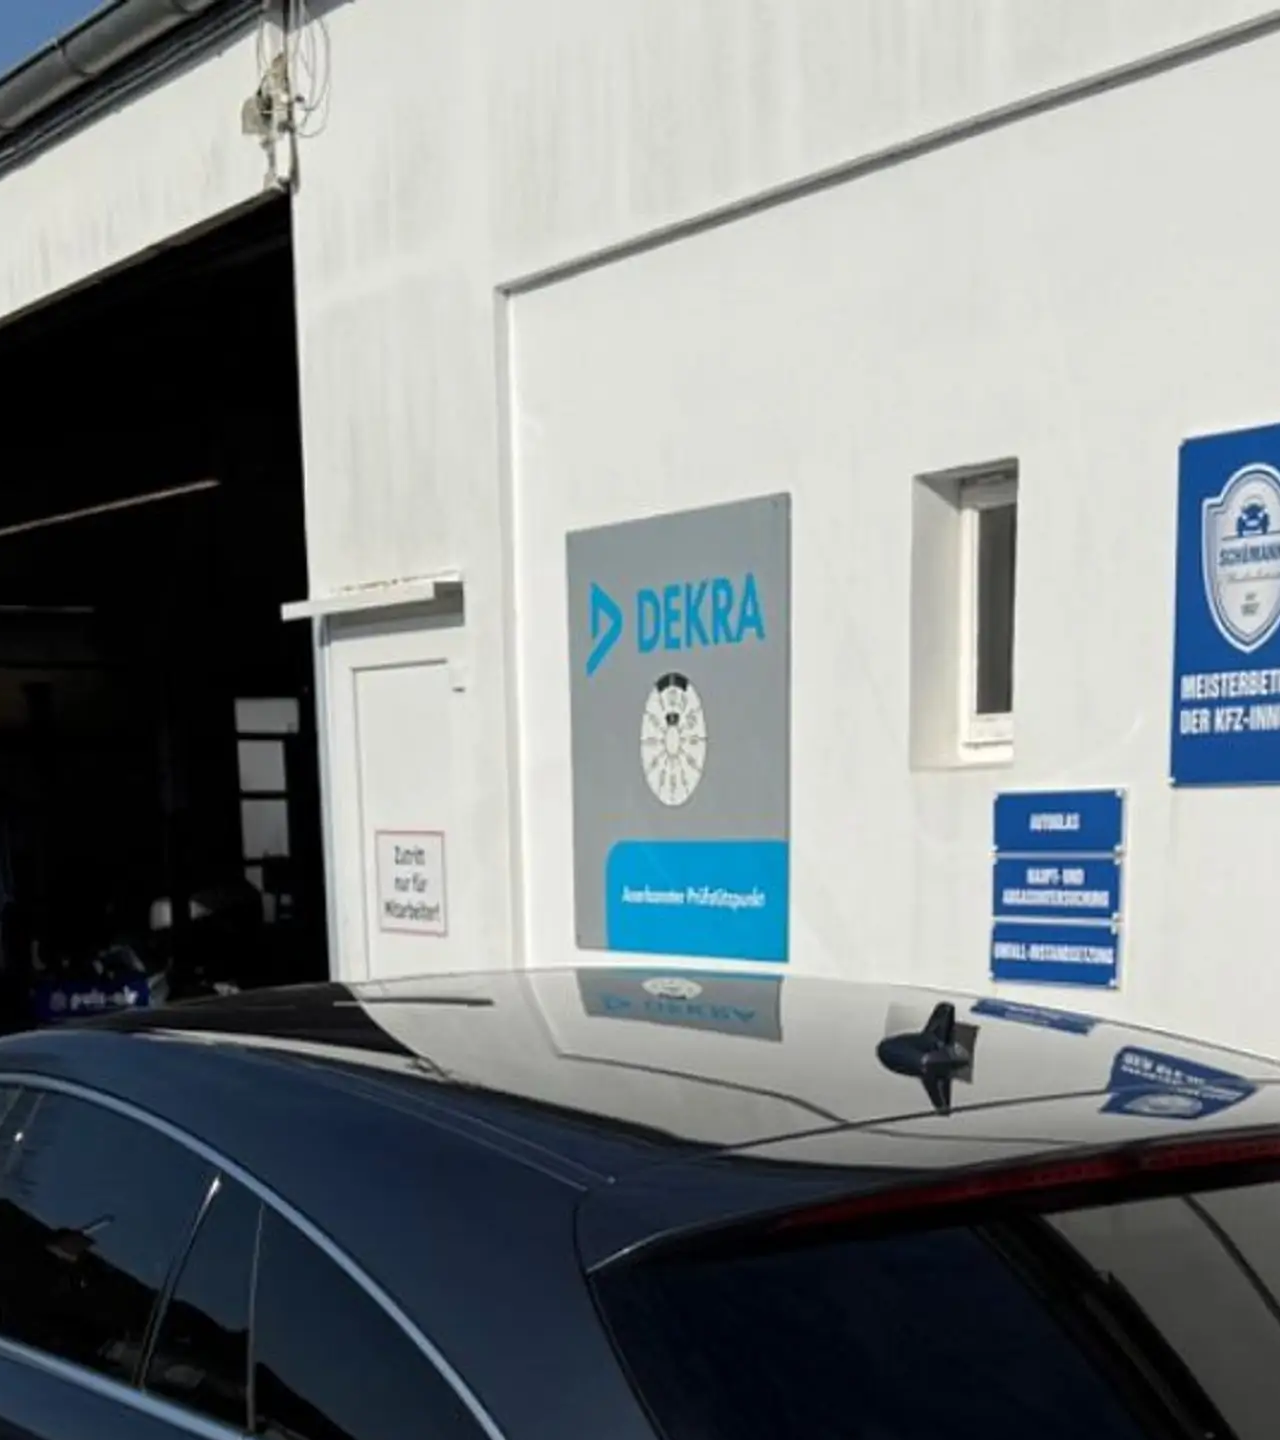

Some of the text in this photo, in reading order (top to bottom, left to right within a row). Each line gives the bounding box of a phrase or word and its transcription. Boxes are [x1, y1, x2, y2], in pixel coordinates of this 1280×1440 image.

[637, 572, 766, 654] DEKRA
[1179, 709, 1211, 735] DER
[394, 872, 428, 893] nur für
[1062, 868, 1084, 886] UND
